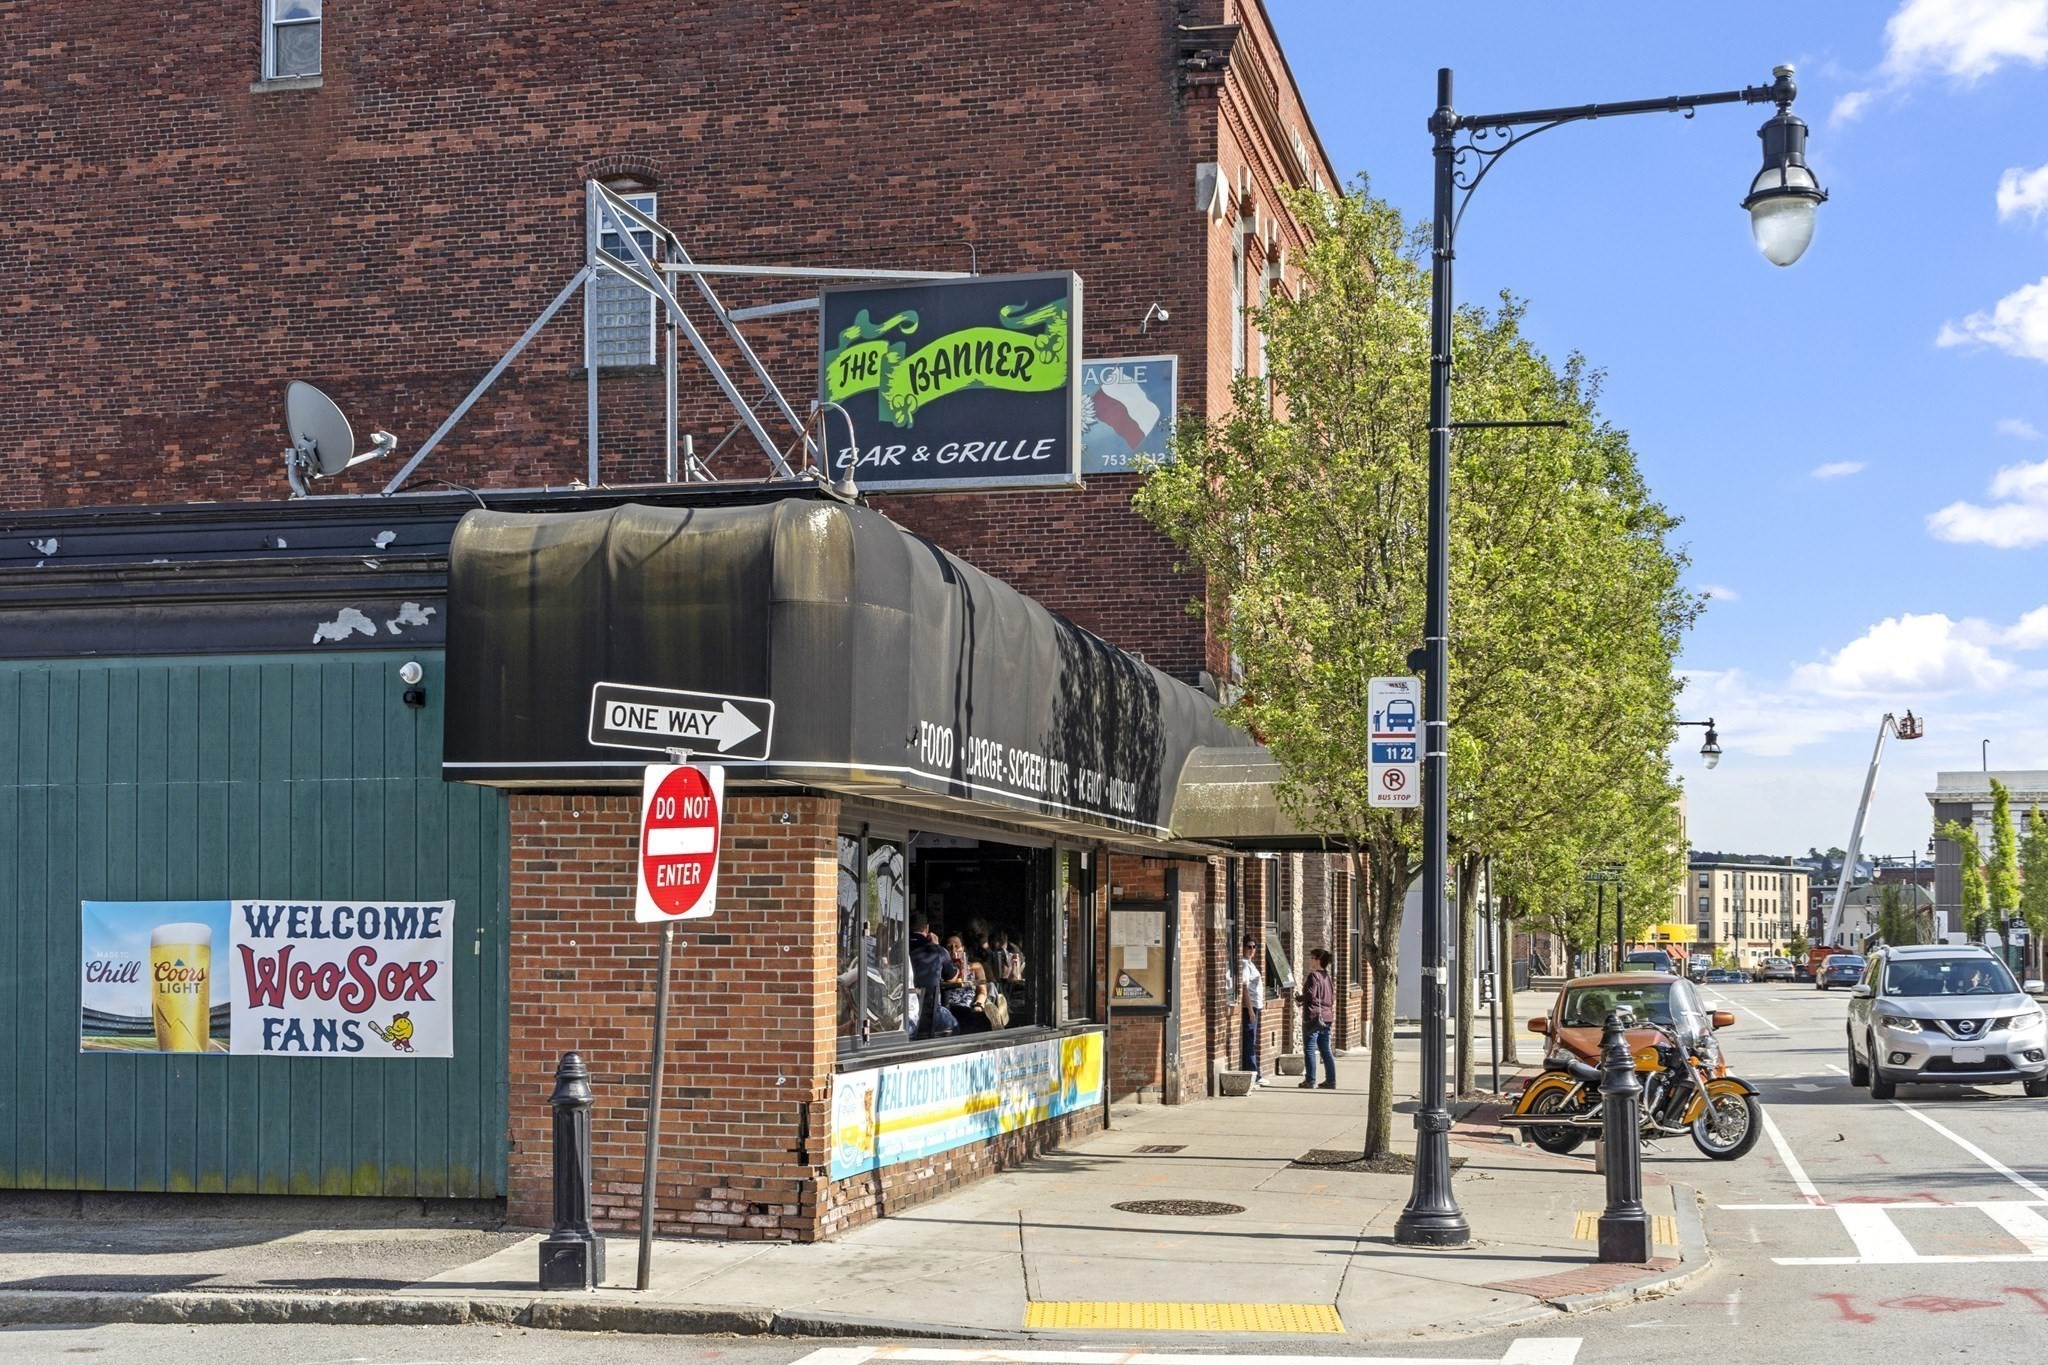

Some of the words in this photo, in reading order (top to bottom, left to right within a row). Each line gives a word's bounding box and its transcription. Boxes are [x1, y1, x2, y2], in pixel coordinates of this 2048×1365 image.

[839, 349, 878, 387] THE
[909, 340, 1034, 396] BANNER
[836, 445, 906, 468] BAR
[912, 446, 930, 462] &
[936, 438, 1056, 463] GRILLE
[611, 705, 659, 731] ONE
[668, 710, 717, 736] WAY
[920, 720, 954, 769] FOOD
[1078, 767, 1101, 806] KENO
[1109, 776, 1135, 814] MUSIC
[1386, 747, 1397, 760] 11
[1400, 747, 1413, 760] 22
[656, 797, 674, 819] DO
[683, 796, 711, 819] NOT
[656, 862, 701, 887] ENTER
[243, 905, 444, 940] WELCOME
[96, 951, 118, 959] MADE
[120, 951, 129, 959] TO
[86, 960, 141, 983] Chill
[154, 961, 207, 982] Coors
[160, 983, 200, 994] LIGHT
[262, 1018, 365, 1052] FANS
[877, 1072, 903, 1112] REAL
[905, 1068, 929, 1107] ICED
[950, 1061, 969, 1098] REAL
